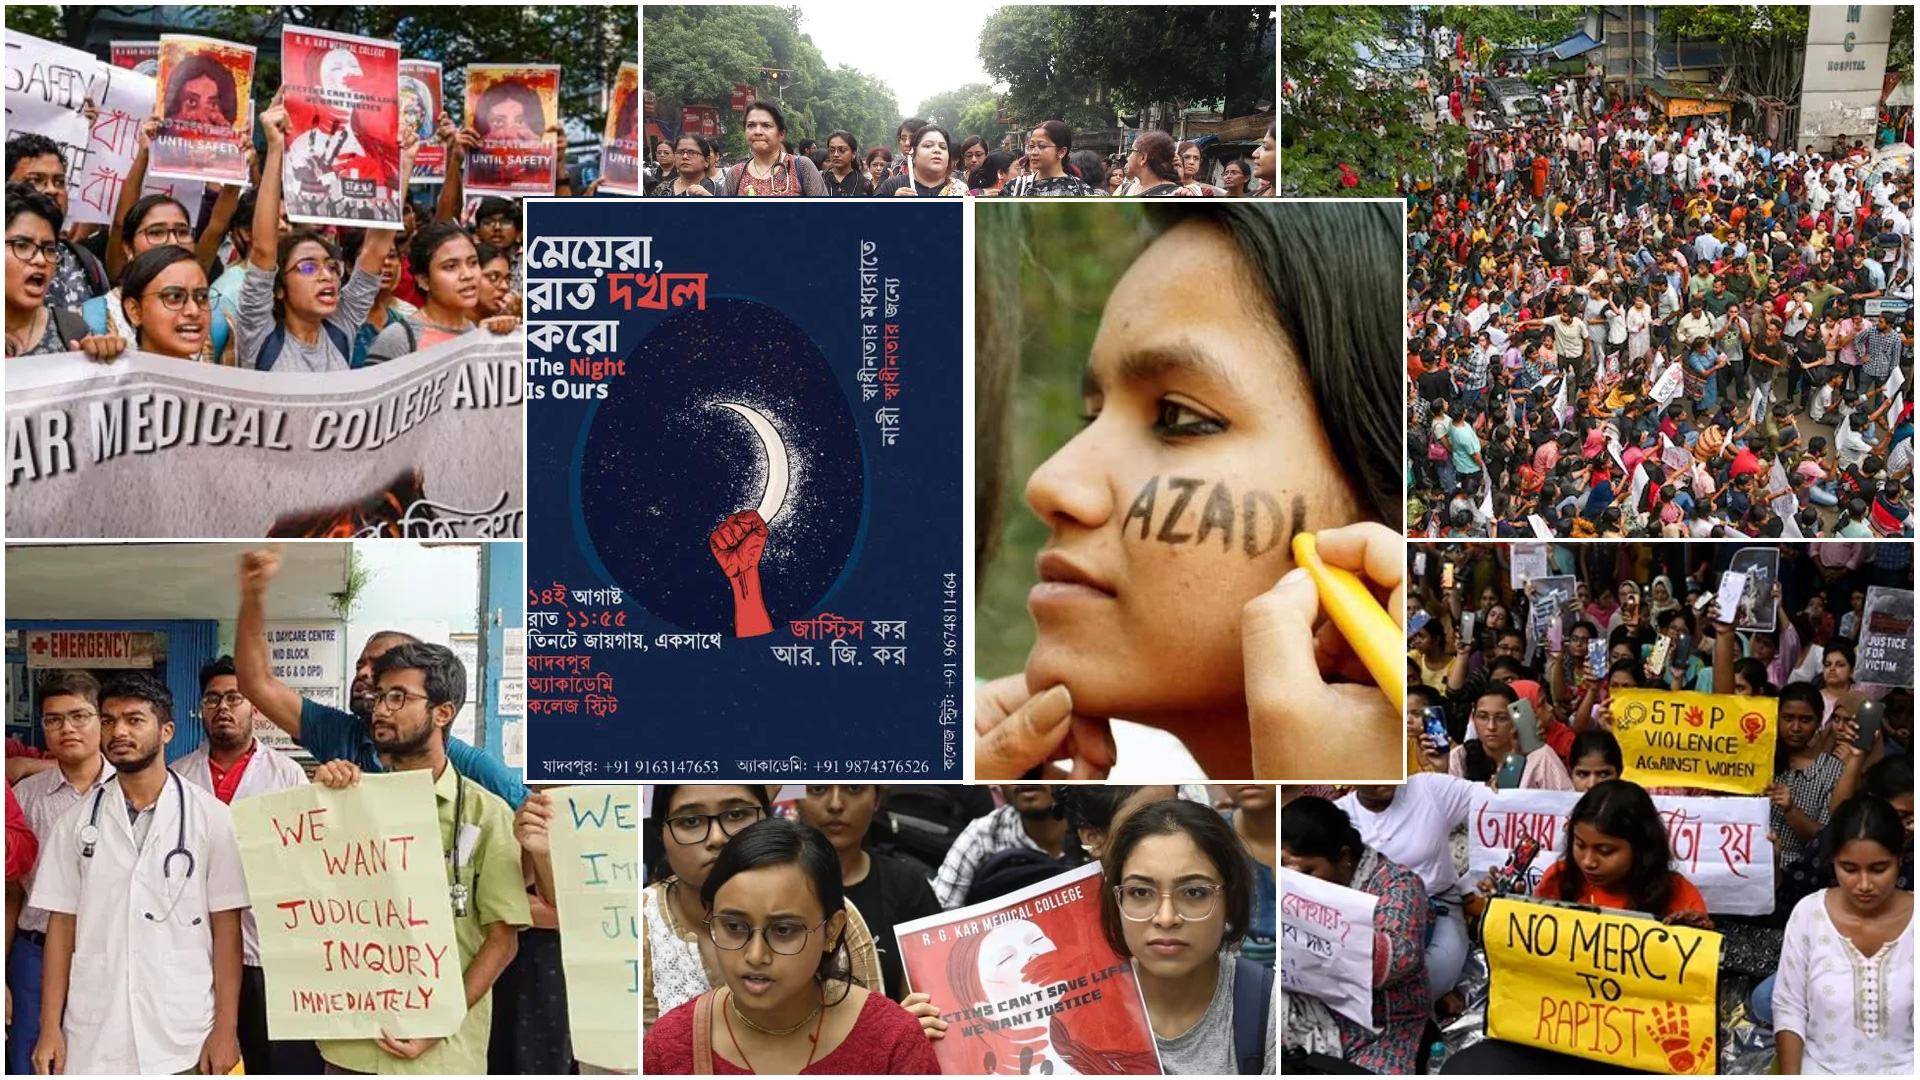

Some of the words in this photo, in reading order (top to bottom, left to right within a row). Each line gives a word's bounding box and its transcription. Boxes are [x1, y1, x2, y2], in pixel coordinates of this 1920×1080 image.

[1827, 60, 1865, 72] HOSPITAL
[158, 135, 195, 150] UNTIL
[197, 140, 240, 154] SAFETY
[472, 154, 504, 165] UNTIL
[507, 154, 552, 166] SAFETY
[527, 236, 663, 277] মেয়েরা,
[527, 278, 597, 313] রাত
[607, 273, 708, 311] দখল
[859, 239, 878, 319] মধ্যরাতে
[527, 320, 620, 355] করো
[527, 357, 564, 376] The
[569, 357, 625, 380] Night
[857, 324, 878, 402] স্বাধীনতার
[879, 324, 900, 400] স্বাধীনতার
[527, 382, 545, 399] Is
[552, 379, 608, 399] Ours
[88, 391, 292, 465] MEDICAL
[307, 371, 450, 451] COLLEGE
[453, 359, 523, 410] AND
[875, 406, 900, 446] নারী
[1121, 475, 1307, 561] AZADI
[528, 583, 568, 608] ১৪ই
[571, 585, 624, 606] আগাষ্ট
[527, 611, 559, 627] রাত
[566, 610, 627, 628] ১১:৫৫
[789, 612, 864, 640] জাস্টিস
[871, 620, 907, 640] ফর
[943, 573, 957, 656] 9674811464
[51, 632, 131, 658] EMERGENCY
[276, 630, 306, 642] DAYCARE
[308, 629, 335, 641] CENTRE
[527, 629, 577, 650] তিনটে
[583, 632, 649, 652] জায়গায়,
[655, 631, 722, 650] একসাথে
[1867, 636, 1908, 649] JUSTICE
[286, 647, 310, 660] BLOCK
[527, 655, 591, 674] যাদবপুর
[770, 643, 821, 666] আর.
[829, 639, 863, 666] জি.
[871, 646, 907, 666] কর
[1865, 647, 1886, 658] FOR
[1865, 659, 1897, 672] VICTIM
[527, 672, 613, 693] অ্যাকাডেমি
[944, 663, 957, 688] +91
[527, 699, 579, 715] কলেজ
[585, 694, 619, 717] স্ট্রিট
[944, 730, 956, 771] কলেজ
[1645, 730, 1739, 754] VIOLENCE
[603, 760, 628, 773] +91
[635, 760, 719, 774] 9163147653
[813, 760, 839, 773] +91
[845, 760, 929, 773] 9874376526
[1636, 755, 1701, 773] AGAINST
[1705, 760, 1755, 777] WOMEN
[569, 794, 635, 829] WE
[271, 808, 327, 846] WE
[323, 836, 414, 876] WANT
[277, 898, 428, 929] JUDICIAL
[922, 932, 935, 946] R.
[939, 929, 951, 942] G.
[955, 919, 980, 939] KAR
[983, 908, 1034, 931] MEDICAL
[1035, 885, 1084, 915] COLLEGE
[323, 940, 448, 979] INQURY
[1507, 912, 1558, 956] NO
[1569, 919, 1703, 985] MERCY
[292, 985, 433, 1013] IMMEDIATELY
[998, 989, 1045, 1013] CAN'T
[1048, 976, 1088, 999] SAVE
[1091, 961, 1132, 984] LIFE
[1576, 972, 1621, 1001] TO
[961, 1023, 985, 1038] WE
[988, 1012, 1033, 1033] WANT
[1036, 989, 1103, 1021] JUSTICE
[1534, 996, 1645, 1058] RAPIST
